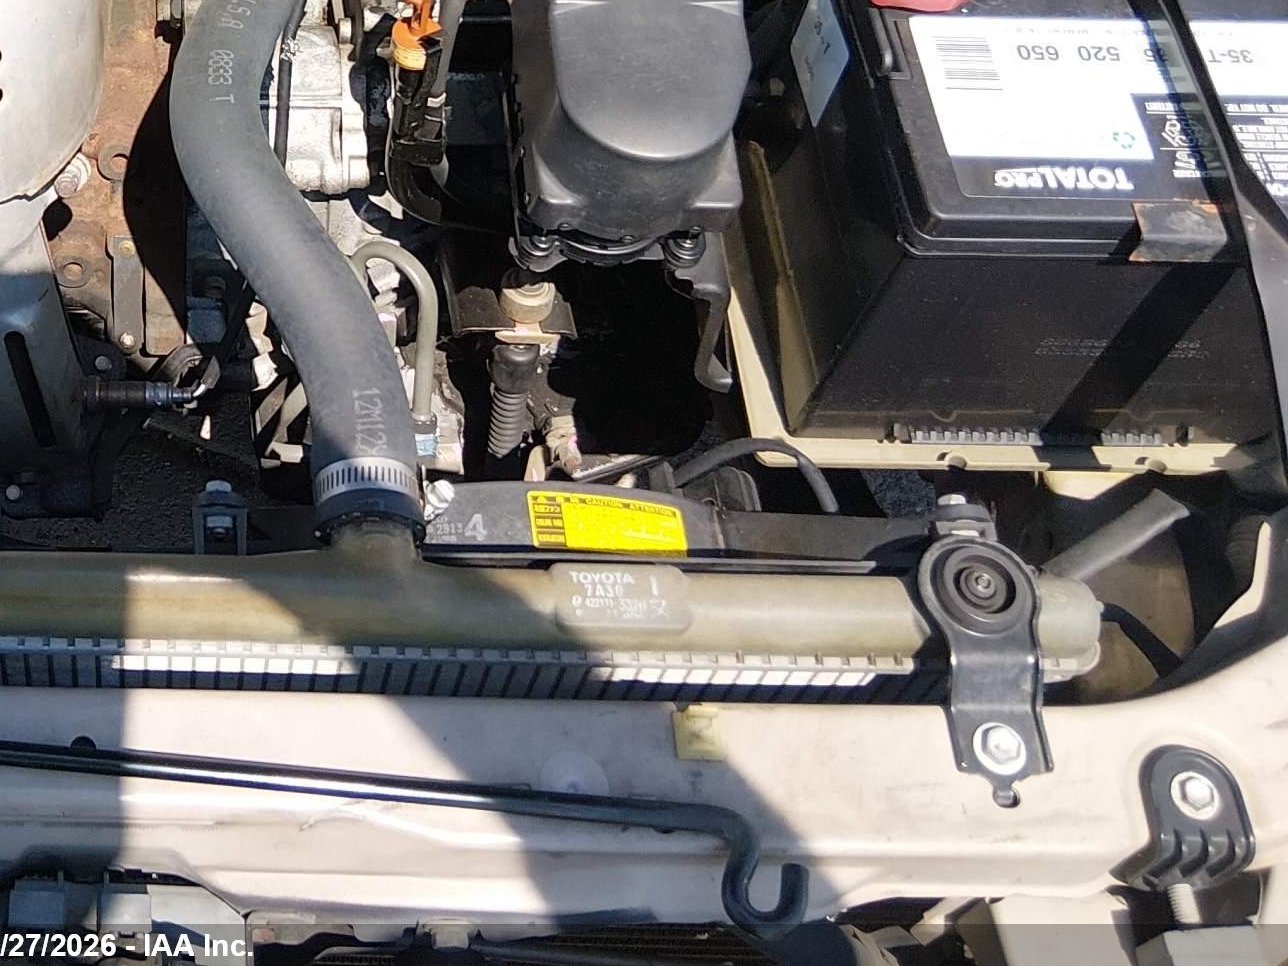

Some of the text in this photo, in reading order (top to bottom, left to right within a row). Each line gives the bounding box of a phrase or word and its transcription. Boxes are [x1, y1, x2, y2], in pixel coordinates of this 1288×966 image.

[1016, 43, 1060, 62] 650
[1077, 44, 1120, 62] 520
[1208, 47, 1254, 64] 35-T
[207, 49, 235, 86] 0833
[993, 165, 1135, 191] TOTALPRO
[463, 513, 488, 542] 4
[568, 571, 635, 584] TOYOTA
